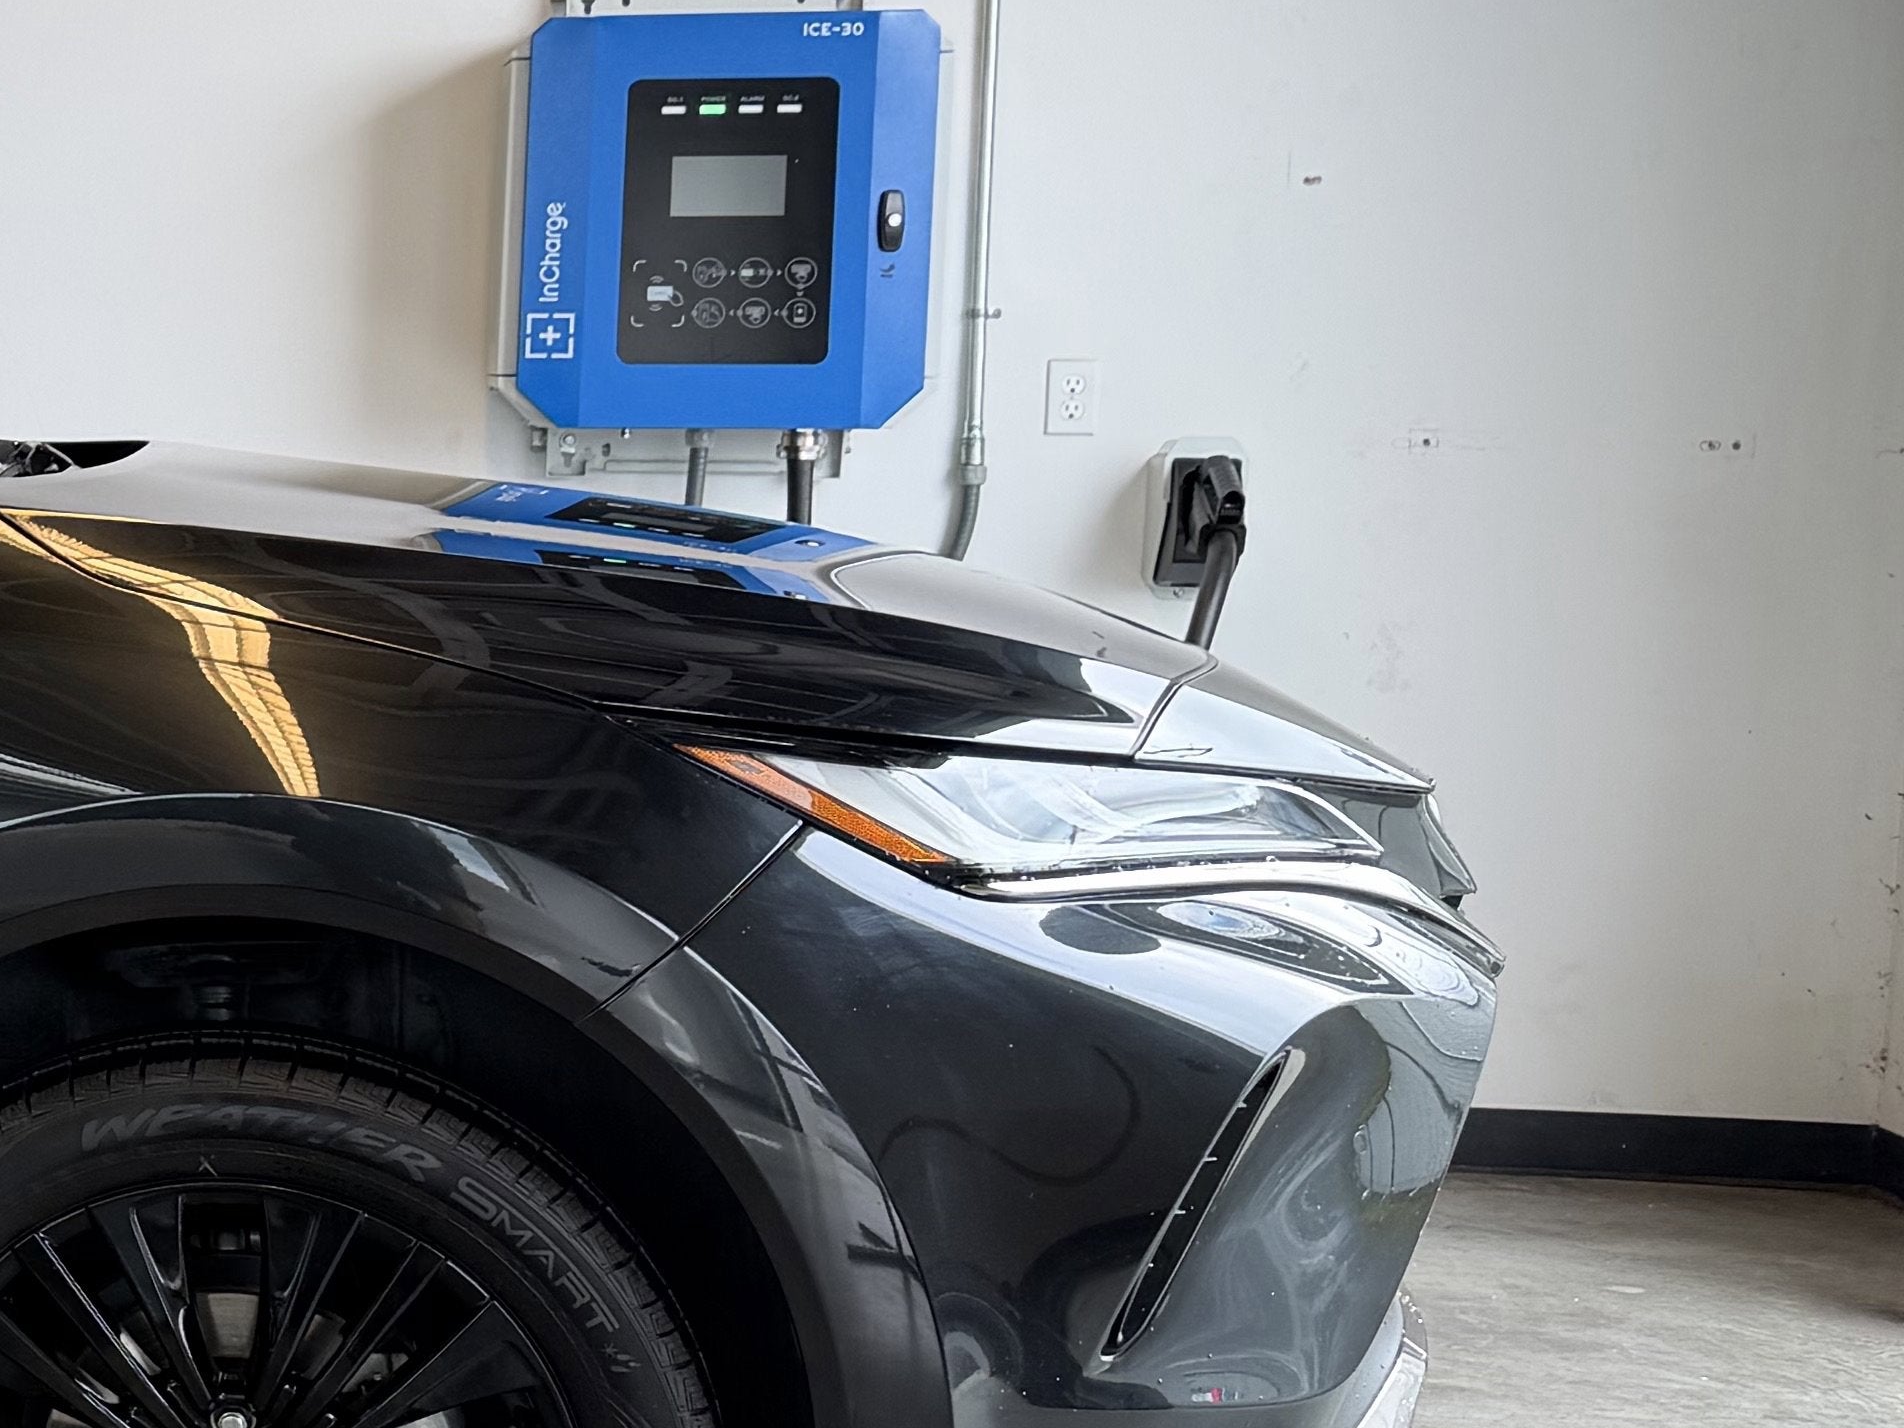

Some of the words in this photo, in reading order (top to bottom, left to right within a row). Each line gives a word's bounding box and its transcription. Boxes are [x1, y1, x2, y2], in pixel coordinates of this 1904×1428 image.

[802, 21, 865, 37] ICE-30
[538, 202, 569, 303] InCharge
[80, 1103, 443, 1184] WEATHER
[449, 1176, 620, 1332] SMART
